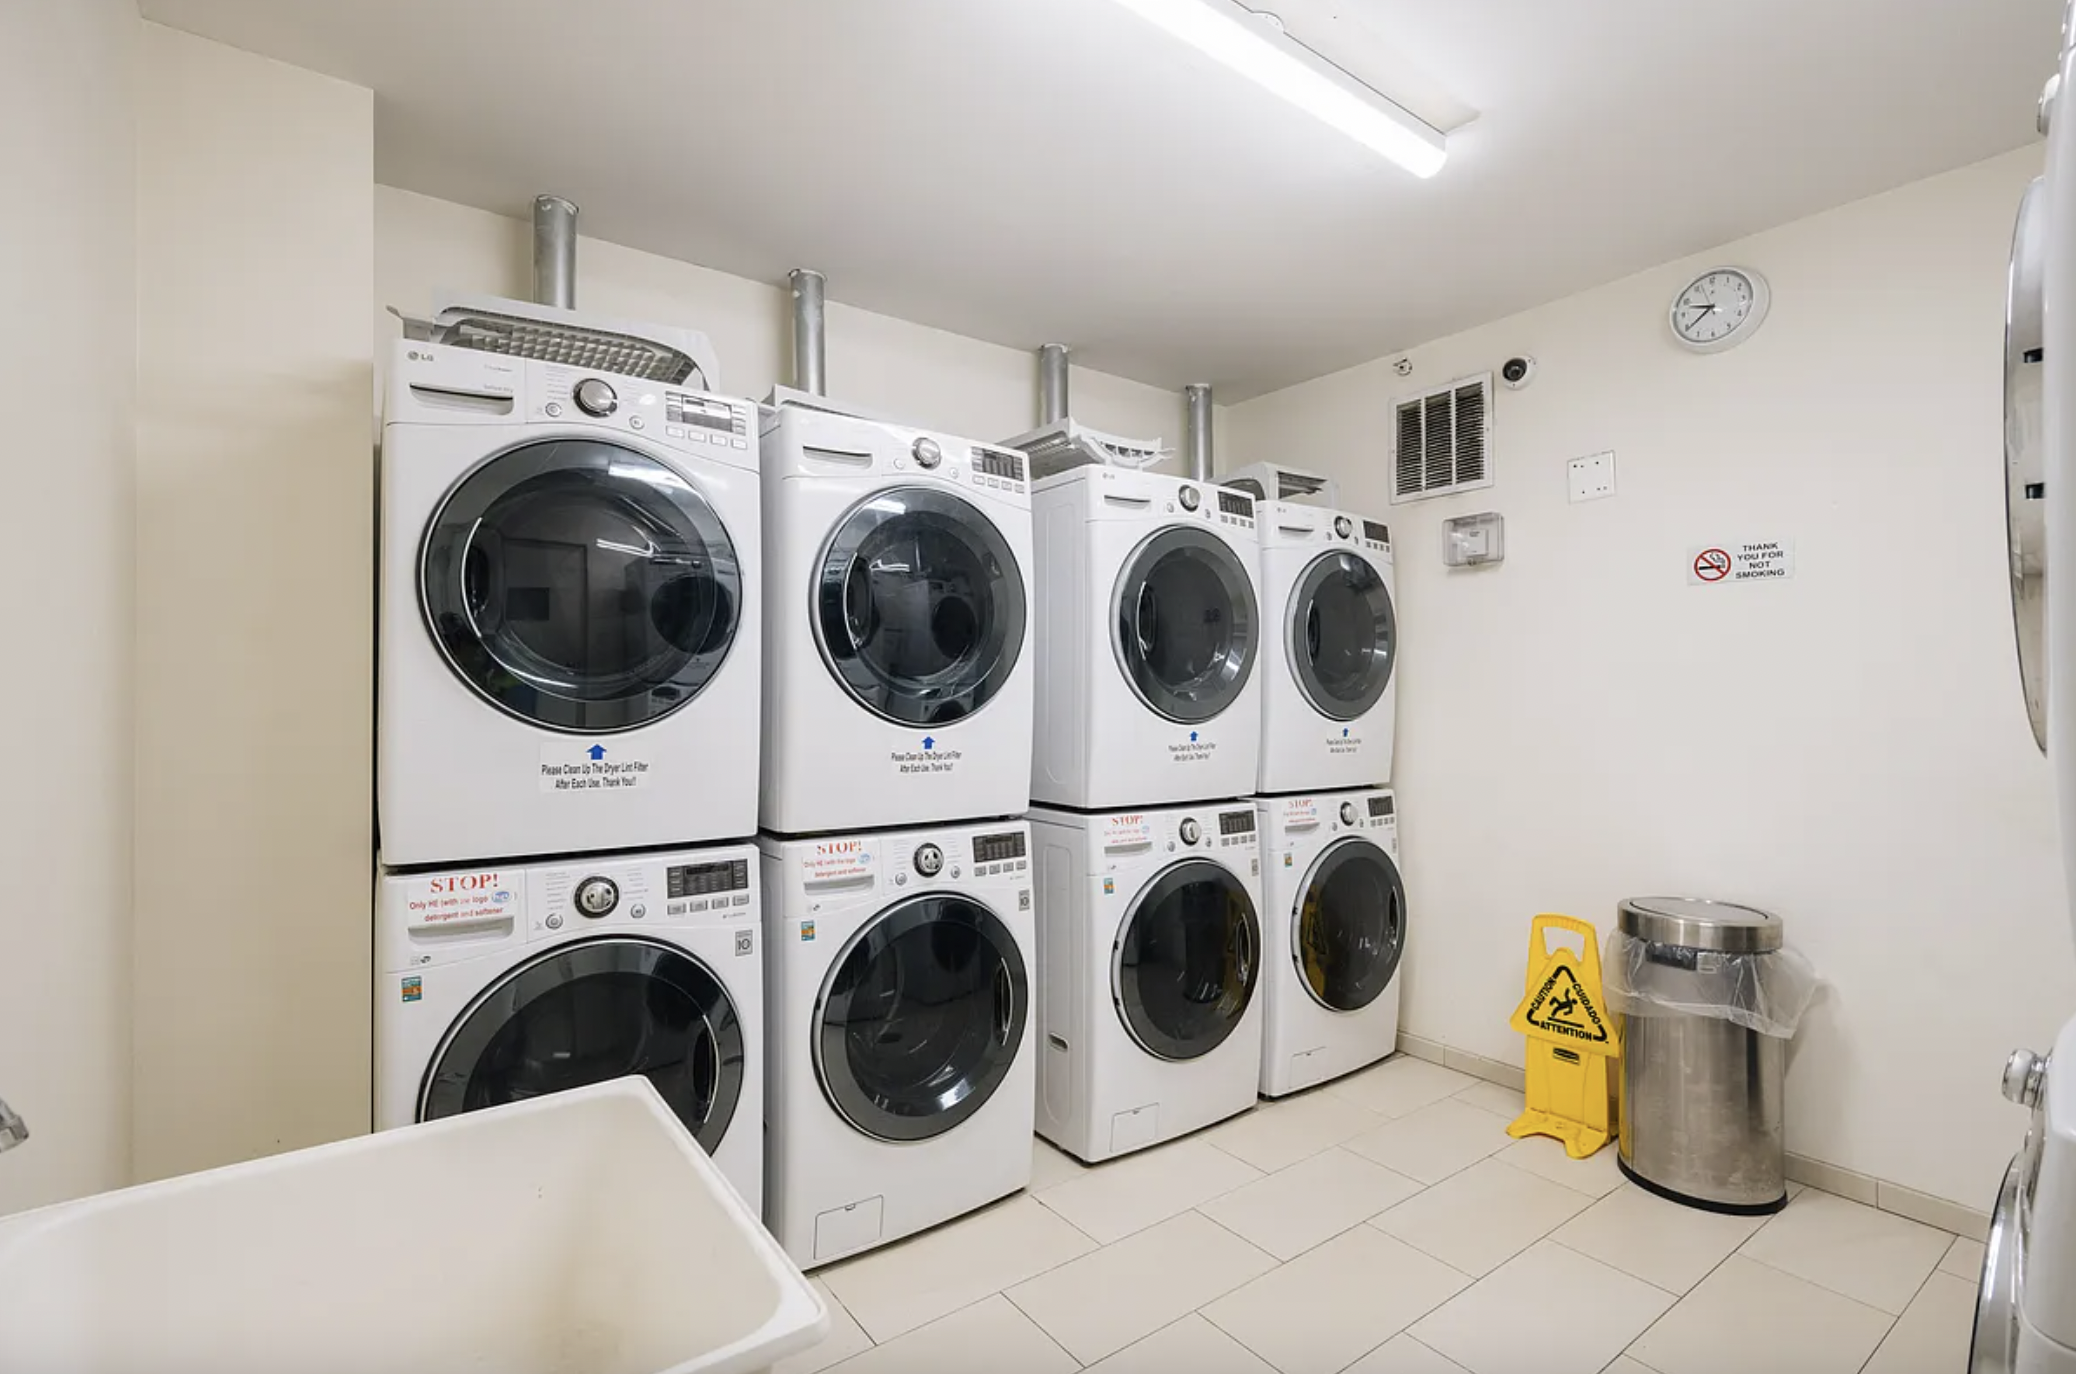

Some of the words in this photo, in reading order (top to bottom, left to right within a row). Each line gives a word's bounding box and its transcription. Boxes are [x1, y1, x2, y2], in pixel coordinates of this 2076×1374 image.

[1742, 542, 1778, 552] THANK
[1761, 550, 1784, 558] FOR
[1749, 561, 1771, 569] NOT
[1736, 569, 1784, 579] SMOKING
[542, 764, 562, 776] Please
[563, 764, 581, 774] Clean
[582, 764, 590, 775] Up
[592, 763, 603, 774] The
[604, 763, 620, 775] Dryer
[622, 763, 633, 772] Lint
[634, 762, 648, 772] Filter
[556, 779, 570, 789] After
[572, 778, 586, 788] Each
[602, 777, 620, 787] Thank
[817, 841, 862, 855] STOP!
[430, 873, 499, 893] STOP!
[410, 901, 426, 910] Only
[472, 895, 488, 904] logo
[424, 911, 459, 922] detergent
[475, 907, 504, 916] softener
[1530, 977, 1557, 1010] CAUTION
[1572, 983, 1600, 1024] CUIDADO
[1540, 1021, 1592, 1041] ATTENTION
